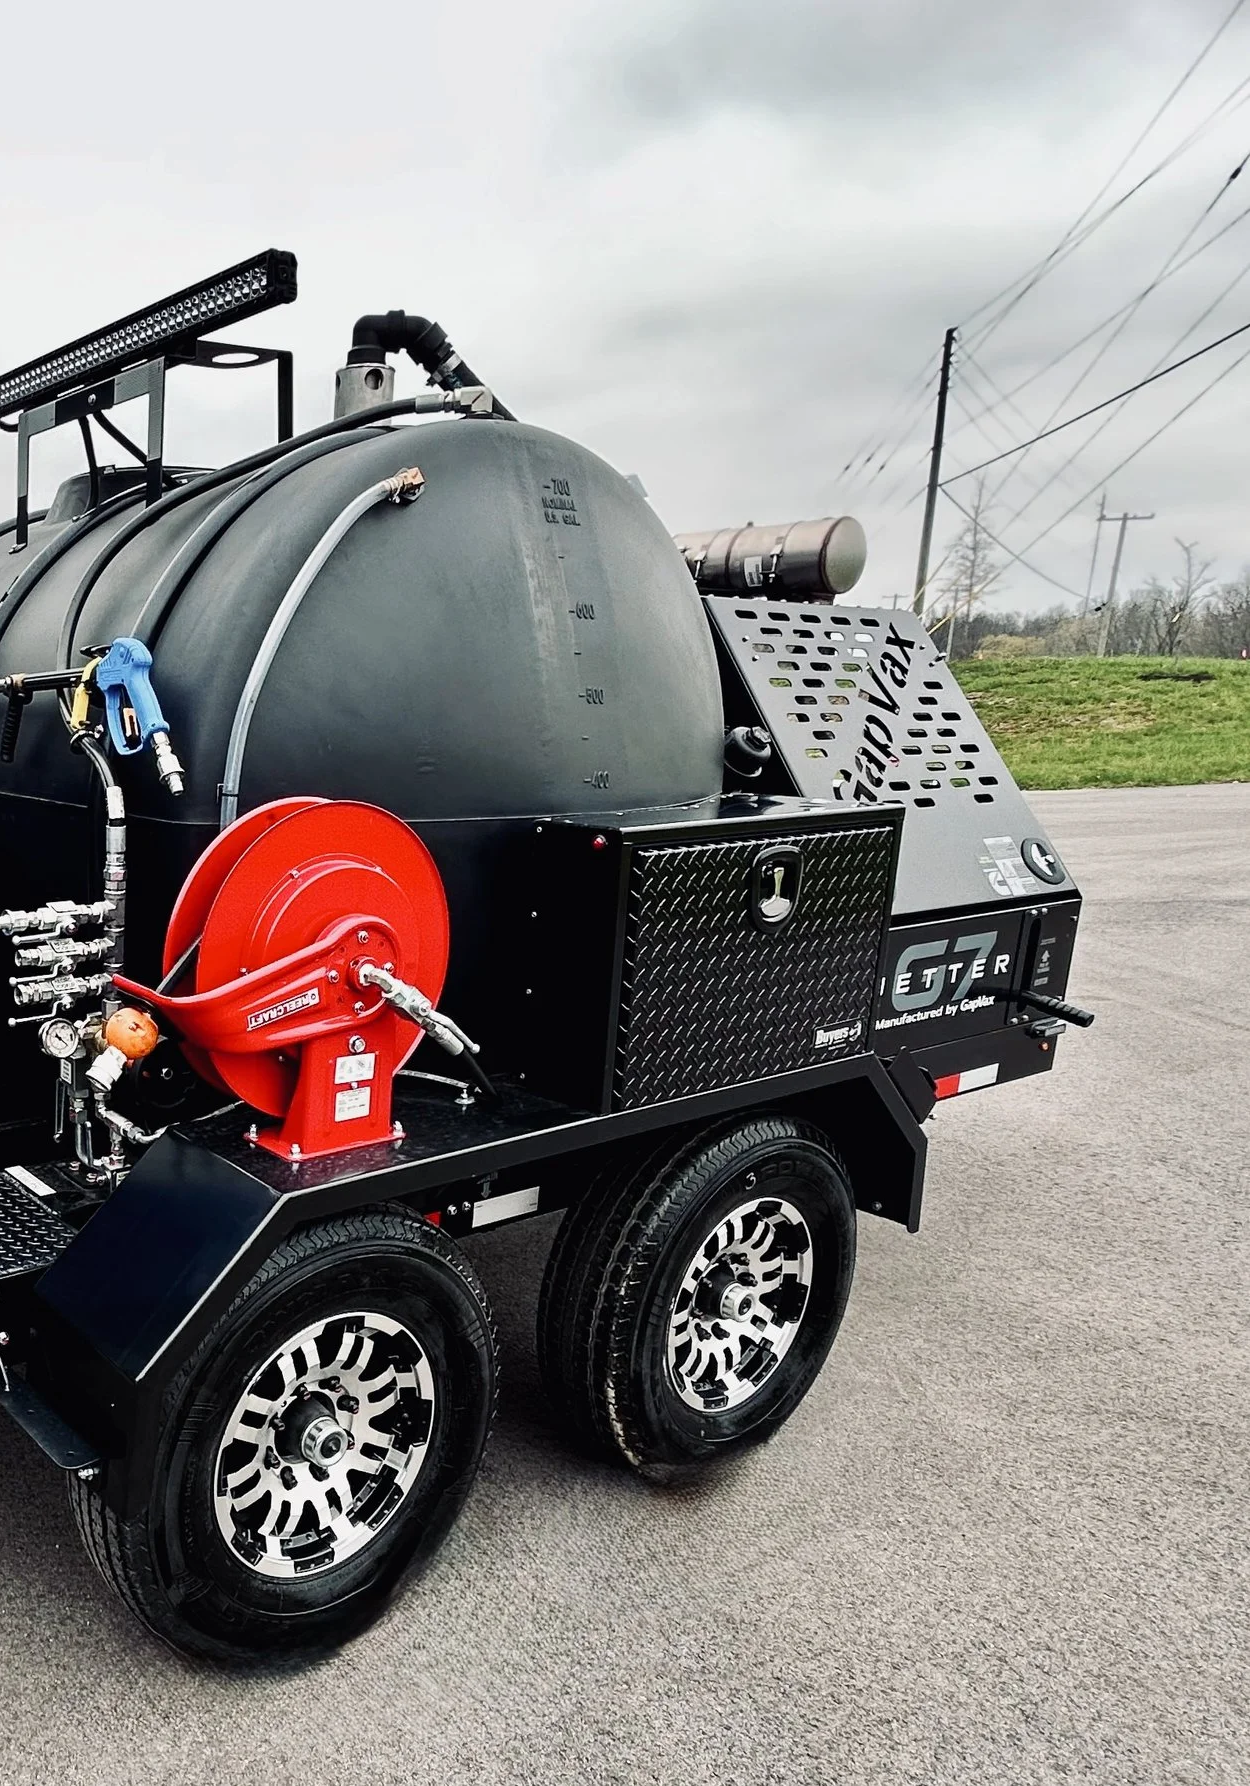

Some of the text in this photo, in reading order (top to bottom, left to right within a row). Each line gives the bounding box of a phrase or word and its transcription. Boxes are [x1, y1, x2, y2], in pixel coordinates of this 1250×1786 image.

[576, 603, 595, 620] 600
[586, 687, 604, 705] 500
[892, 930, 998, 1012] G7
[250, 996, 310, 1027] REELCRAFT
[875, 995, 996, 1030] Manufactured by GapVax
[815, 1027, 850, 1045] Buyers
[745, 1172, 756, 1190] 3
